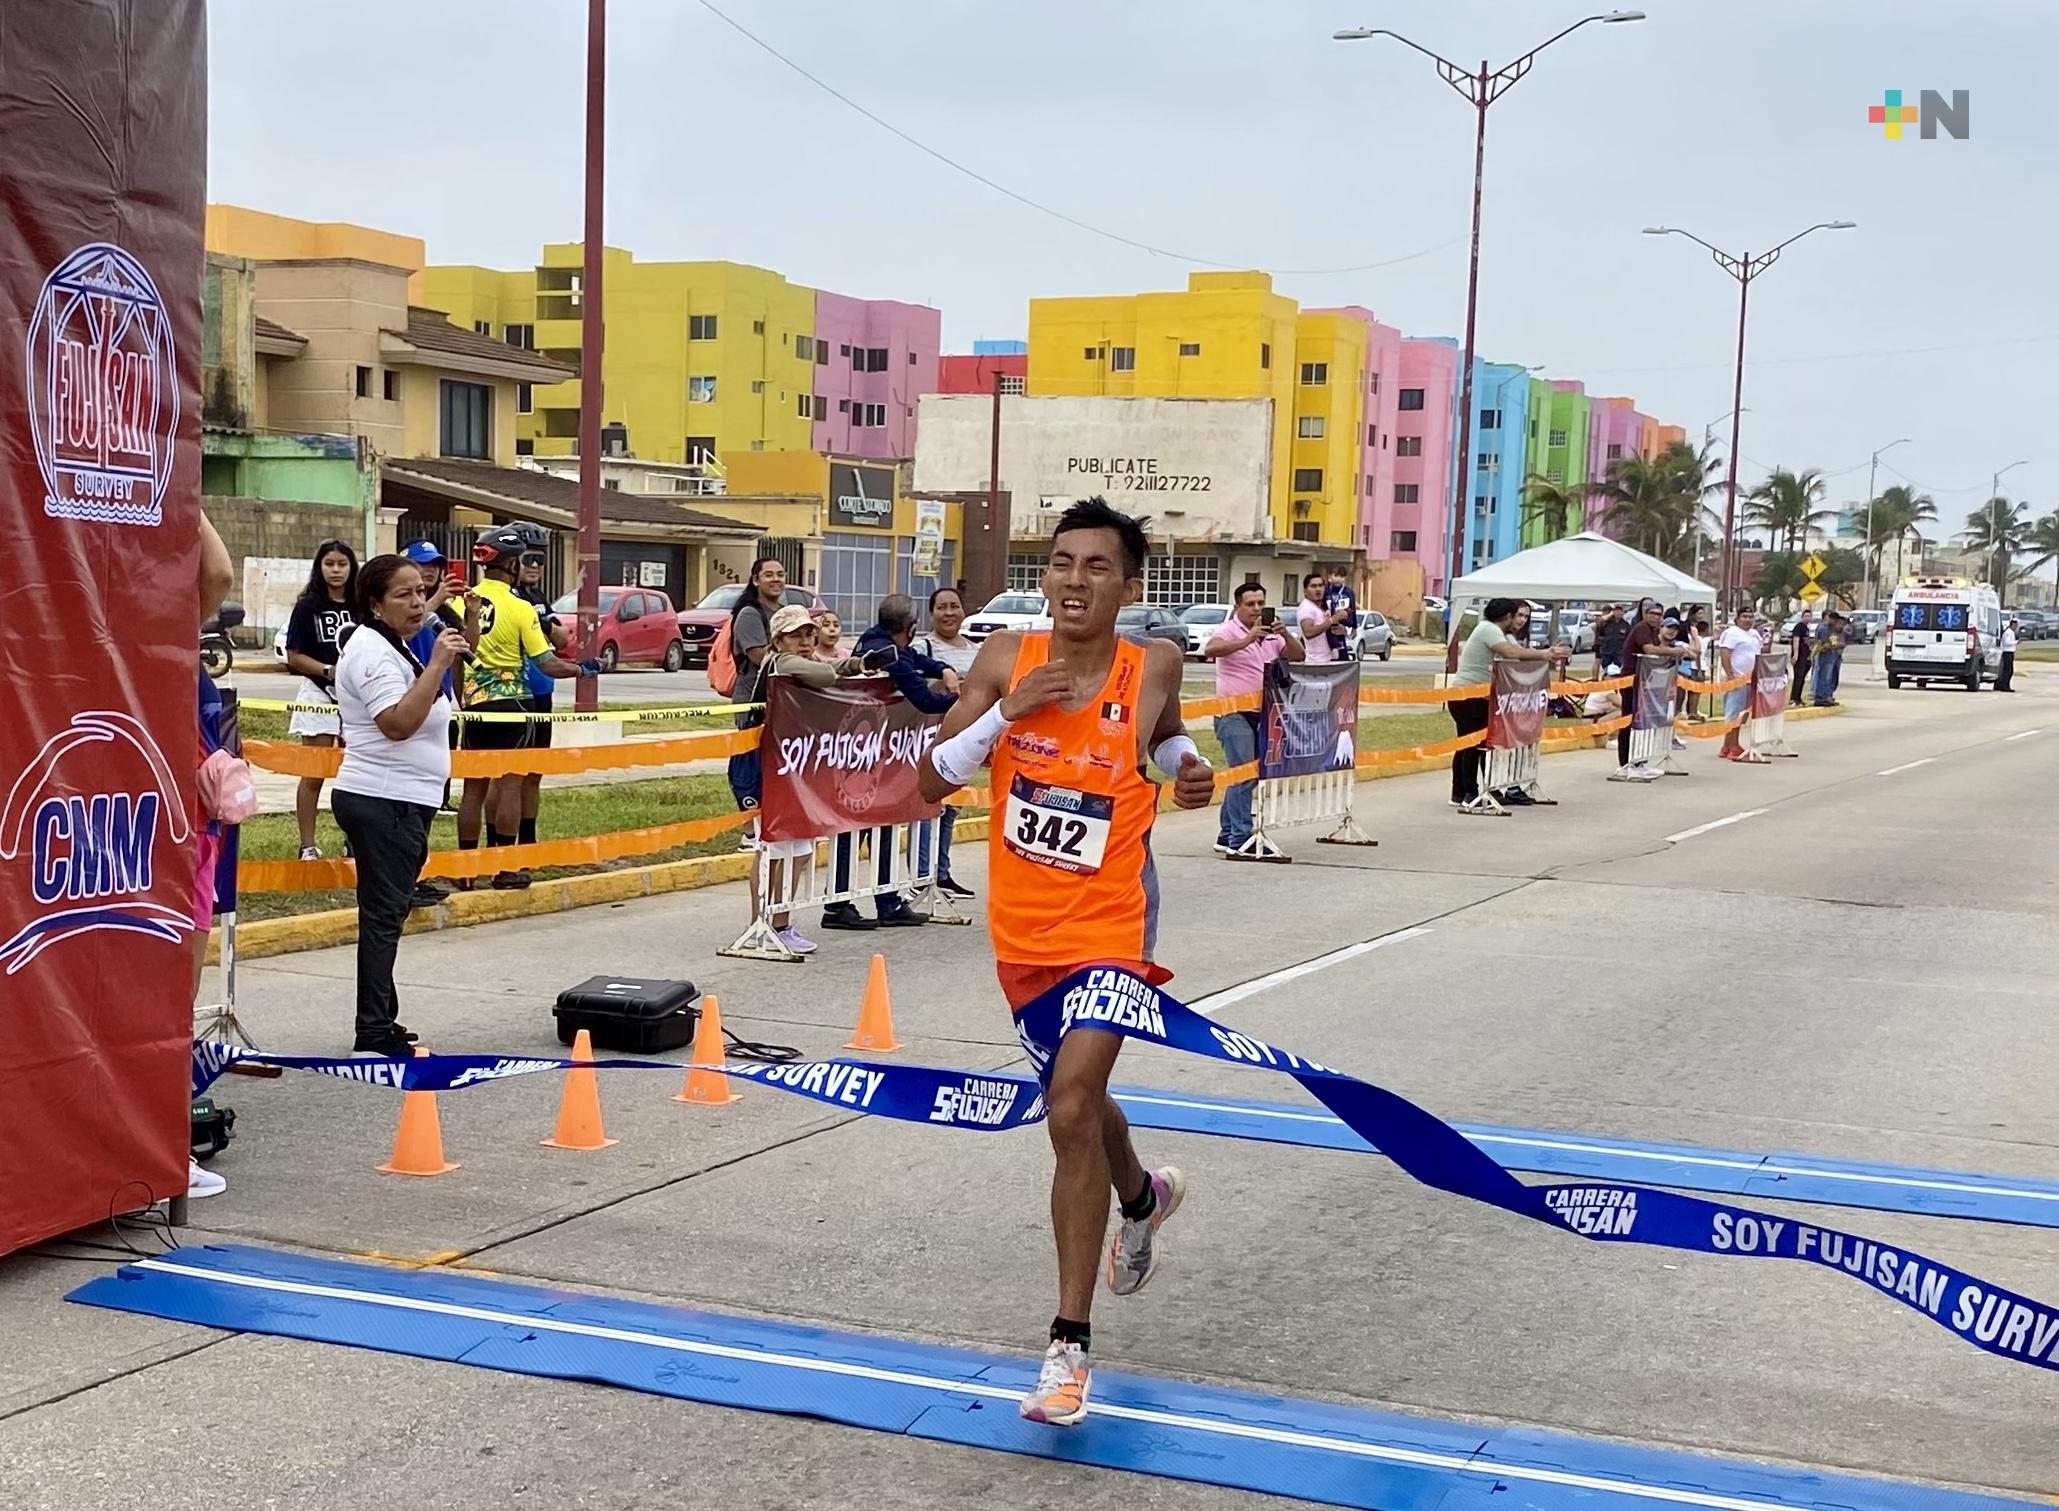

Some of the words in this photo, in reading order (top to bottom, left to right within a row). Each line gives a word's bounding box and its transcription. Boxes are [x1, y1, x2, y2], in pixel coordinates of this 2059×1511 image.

[75, 474, 133, 500] SURVEY
[1067, 457, 1158, 474] PUBLICATE
[1908, 591, 1960, 600] AMBULANCIA
[777, 733, 815, 777] SOY
[813, 719, 889, 777] FUJISAN
[885, 722, 942, 772] SURVE
[32, 791, 159, 904] CMM
[1018, 808, 1087, 857] 342
[1086, 969, 1160, 1013] CARRERA
[1071, 988, 1167, 1039] FUJISAN
[765, 1062, 886, 1107] SURVEY
[963, 1078, 1019, 1100] CARRERA
[951, 1093, 1014, 1125] FUJISAN
[1544, 1188, 1637, 1208] CARRERA
[1712, 1212, 1785, 1253] SOY
[1796, 1225, 1949, 1315] FUJISAN
